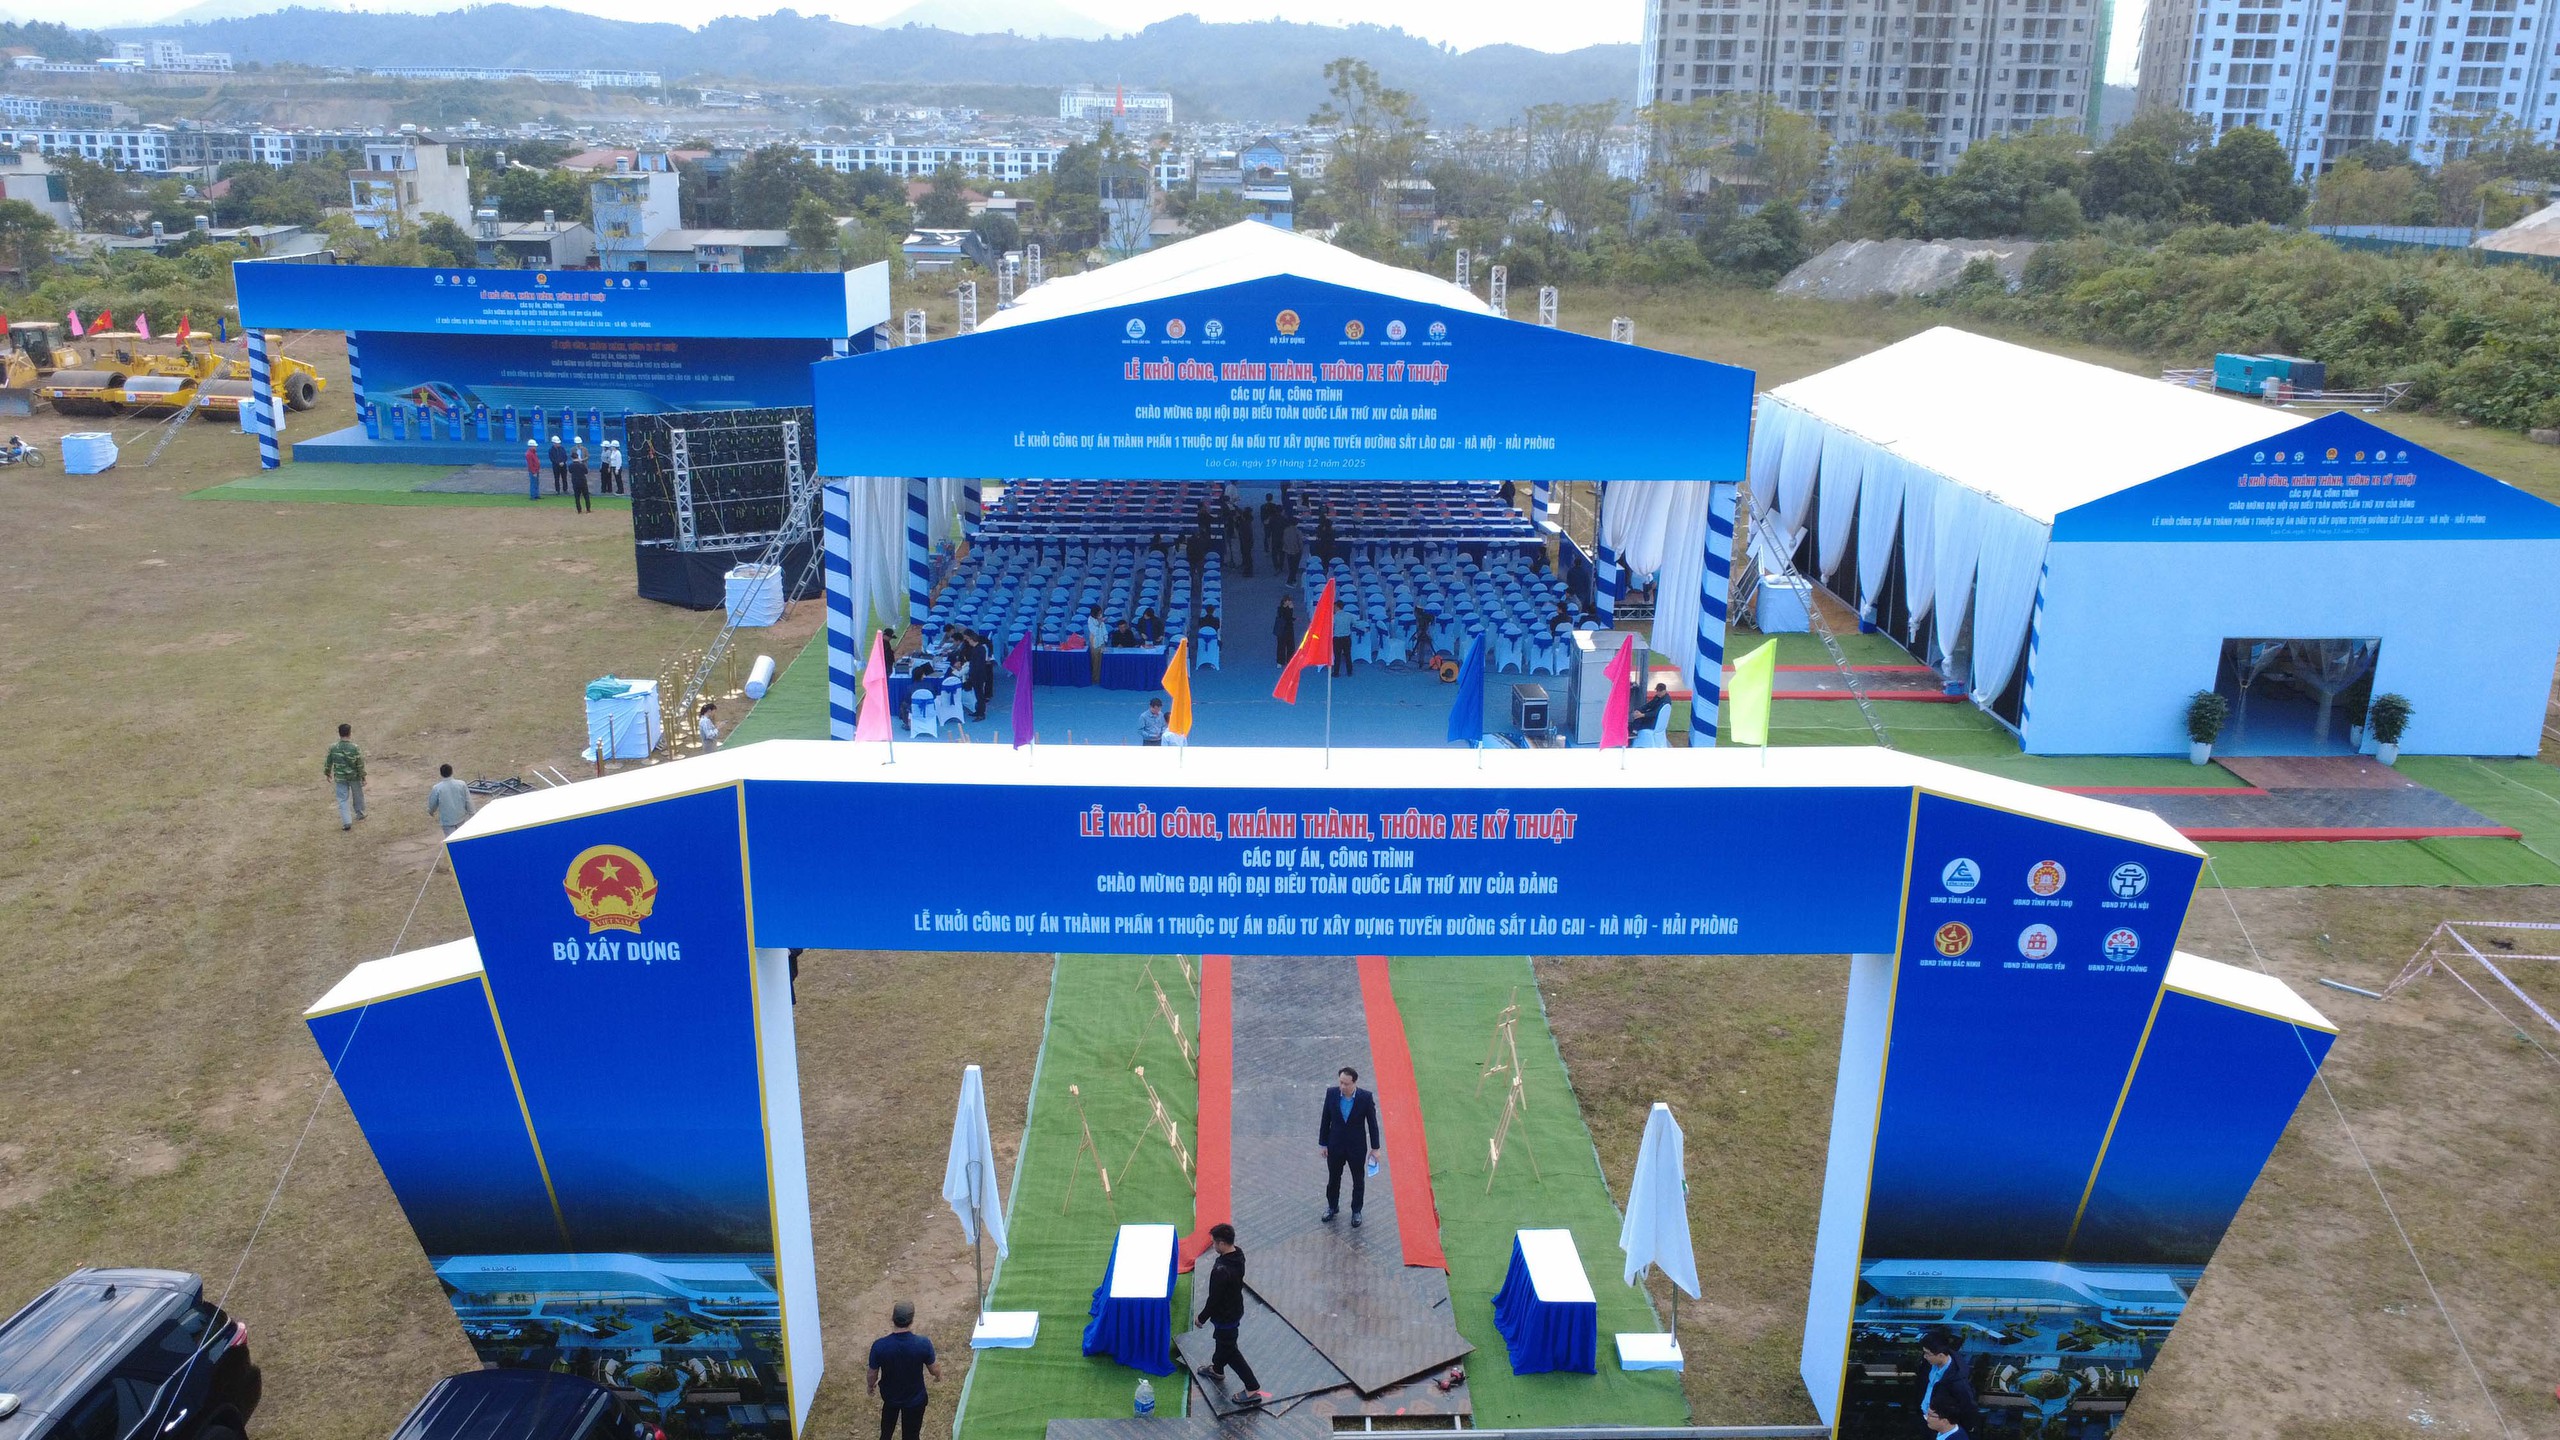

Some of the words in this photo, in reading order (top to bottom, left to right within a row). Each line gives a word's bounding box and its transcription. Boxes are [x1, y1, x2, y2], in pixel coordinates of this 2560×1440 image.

[1124, 357, 1140, 380] LỄ
[1143, 356, 1174, 380] KHỞI
[1177, 358, 1217, 381] CÔNG,
[1221, 359, 1266, 380] KHÁNH
[1269, 359, 1316, 382] THÀNH,
[1320, 359, 1363, 381] THÔNG
[1367, 363, 1383, 381] XE
[1387, 360, 1404, 381] KỸ
[1407, 360, 1448, 384] THUẬT
[1231, 386, 1249, 400] CÁC
[1252, 388, 1265, 403] DỰ
[1268, 386, 1283, 401] ÁN,
[1287, 385, 1312, 400] CÔNG
[1315, 387, 1342, 401] TRÌNH
[1135, 404, 1160, 418] CHÀO
[1163, 404, 1192, 419] MỪNG
[1195, 406, 1211, 421] ĐẠI
[1214, 404, 1230, 421] HỘI
[1232, 407, 1248, 421] ĐẠI
[1251, 404, 1272, 419] BIỂU
[1275, 404, 1299, 419] TOÀN
[1302, 404, 1327, 420] QUỐC
[1330, 405, 1347, 419] LẦN
[1351, 405, 1369, 419] THỨ
[1372, 407, 1387, 420] XIV
[1390, 404, 1408, 419] CỦA
[1411, 404, 1436, 420] ĐẢNG
[1014, 431, 1025, 446] LỄ
[1027, 430, 1049, 447] KHỞI
[1052, 432, 1078, 447] CÔNG
[1080, 434, 1094, 449] DỰ
[1097, 432, 1110, 448] ÁN
[1112, 433, 1143, 448] THÀNH
[1146, 433, 1171, 447] PHẦN
[1174, 436, 1179, 448] 1
[1181, 433, 1212, 450] THUỘC
[1215, 435, 1228, 450] DỰ
[1231, 433, 1243, 448] ÁN
[1246, 433, 1265, 448] ĐẦU
[1268, 435, 1280, 448] TƯ
[1283, 433, 1301, 448] XÂY
[1304, 435, 1330, 451] DỰNG
[1332, 434, 1361, 448] TUYẾN
[1364, 433, 1396, 449] ĐƯỜNG
[1399, 433, 1416, 449] SẮT
[1419, 434, 1436, 449] LÀO
[1439, 437, 1455, 449] CAI
[1464, 434, 1477, 449] HÀ
[1480, 434, 1495, 451] NỘI
[1505, 433, 1521, 449] HẢI
[1523, 434, 1555, 449] PHÒNG
[1080, 804, 1103, 836] LỄ
[1109, 803, 1156, 837] KHỞI
[1161, 806, 1222, 840] CÔNG,
[1228, 808, 1296, 838] KHÁNH
[1302, 808, 1374, 841] THÀNH,
[1380, 807, 1446, 839] THÔNG
[1451, 814, 1477, 839] XE
[1483, 808, 1509, 839] KỸ
[1515, 808, 1577, 843] THUẬT
[1242, 846, 1271, 867] CÁC
[1276, 849, 1296, 870] DỰ
[1300, 846, 1324, 869] ÁN,
[1329, 846, 1367, 867] CÔNG
[1372, 846, 1413, 867] TRÌNH
[1097, 871, 1135, 892] CHÀO
[1140, 872, 1184, 892] MỪNG
[1189, 876, 1212, 896] ĐẠI
[1218, 872, 1241, 896] HỘI
[1246, 876, 1269, 896] ĐẠI
[1275, 871, 1305, 893] BIỂU
[1310, 873, 1346, 893] TOÀN
[1351, 873, 1389, 894] QUỐC
[1394, 873, 1421, 893] LẦN
[1426, 874, 1454, 894] THỨ
[1458, 877, 1482, 893] XIV
[1486, 871, 1514, 894] CỦA
[1519, 872, 1557, 893] ĐẢNG
[914, 909, 930, 930] LỄ
[935, 909, 967, 931] KHỞI
[972, 910, 1010, 932] CÔNG
[1015, 914, 1035, 935] DỰ
[1040, 912, 1058, 932] ÁN
[1063, 912, 1109, 933] THÀNH
[1115, 913, 1152, 933] PHẦN
[1157, 917, 1164, 933] 1
[1168, 913, 1214, 937] THUỘC
[1219, 916, 1239, 938] DỰ
[1243, 914, 1262, 934] ÁN
[1267, 914, 1295, 935] ĐẦU
[1300, 917, 1318, 935] TƯ
[1323, 914, 1350, 934] XÂY
[1355, 917, 1394, 938] DỰNG
[1398, 914, 1441, 935] TUYẾN
[1446, 914, 1495, 935] ĐƯỜNG
[1499, 912, 1526, 935] SẮT
[1530, 914, 1557, 935] LÀO
[1561, 918, 1584, 935] CAI
[1600, 914, 1618, 934] HÀ
[1623, 914, 1647, 938] NỘI
[1662, 912, 1686, 934] HẢI
[1690, 914, 1738, 934] PHÒNG
[552, 937, 579, 964] BỘ
[585, 936, 620, 960] XÂY
[627, 940, 680, 964] DỰNG
